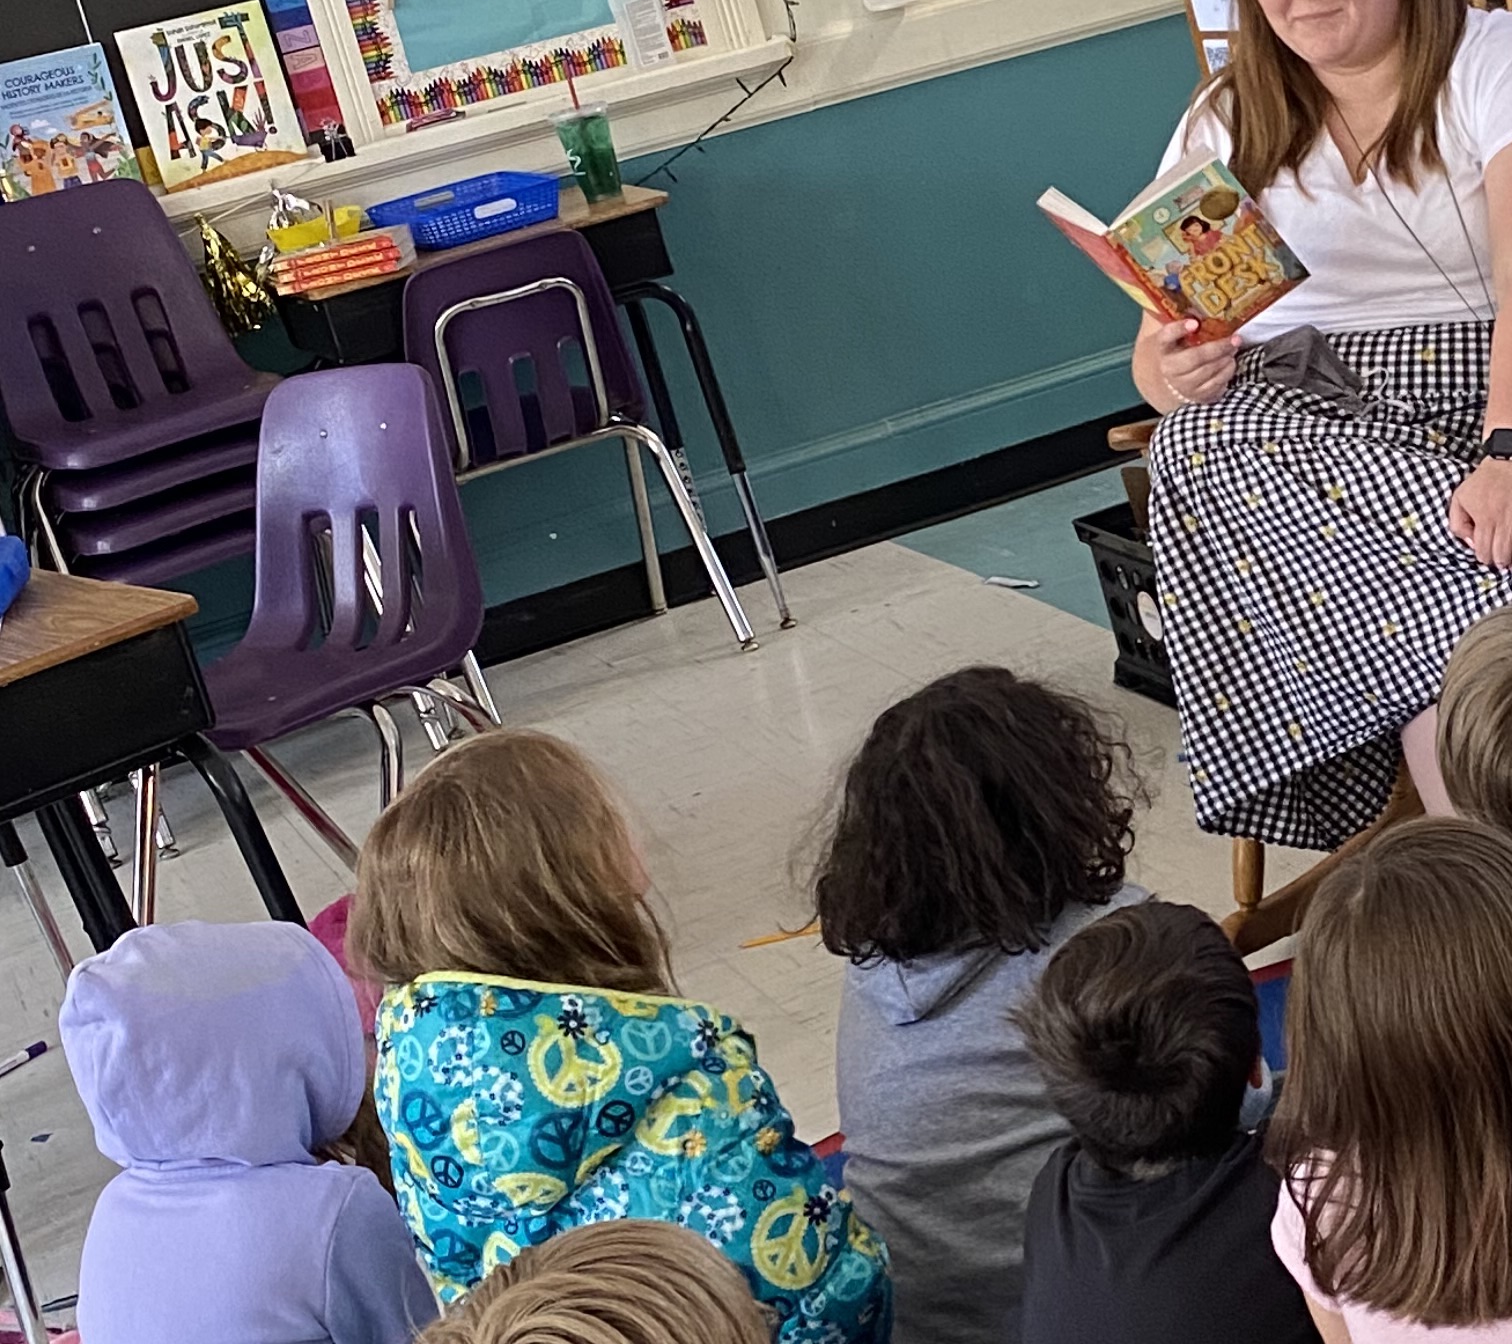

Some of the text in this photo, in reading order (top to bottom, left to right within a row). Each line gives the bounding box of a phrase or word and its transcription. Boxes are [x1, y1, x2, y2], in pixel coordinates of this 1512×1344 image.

[1, 74, 85, 100] HISTORY MAKERS
[4, 67, 76, 88] COURAGEOUS
[150, 13, 262, 102] JUST
[164, 80, 278, 160] ASK!
[1181, 223, 1267, 296] FRONT
[1200, 253, 1279, 317] DESK
